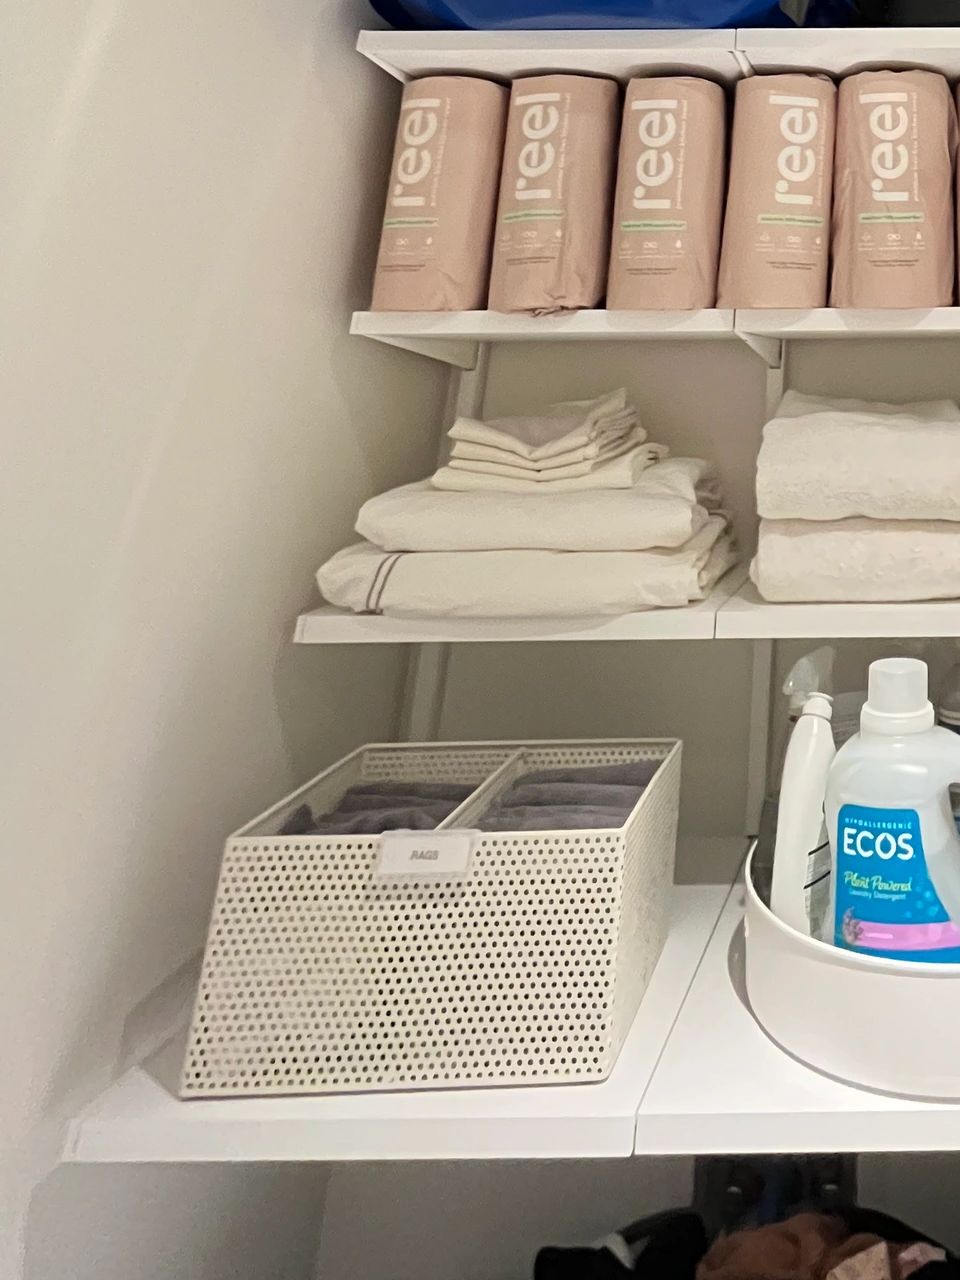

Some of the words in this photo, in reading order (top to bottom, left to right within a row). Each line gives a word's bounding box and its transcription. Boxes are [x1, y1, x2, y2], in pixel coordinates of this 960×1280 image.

[391, 98, 441, 207] reel
[514, 93, 560, 200] reel
[631, 99, 678, 209] reel
[769, 95, 819, 205] reel
[859, 92, 909, 202] reel
[409, 850, 439, 860] RAGS
[843, 826, 914, 861] ECOS
[844, 870, 870, 889] Plant
[871, 874, 913, 891] Powered
